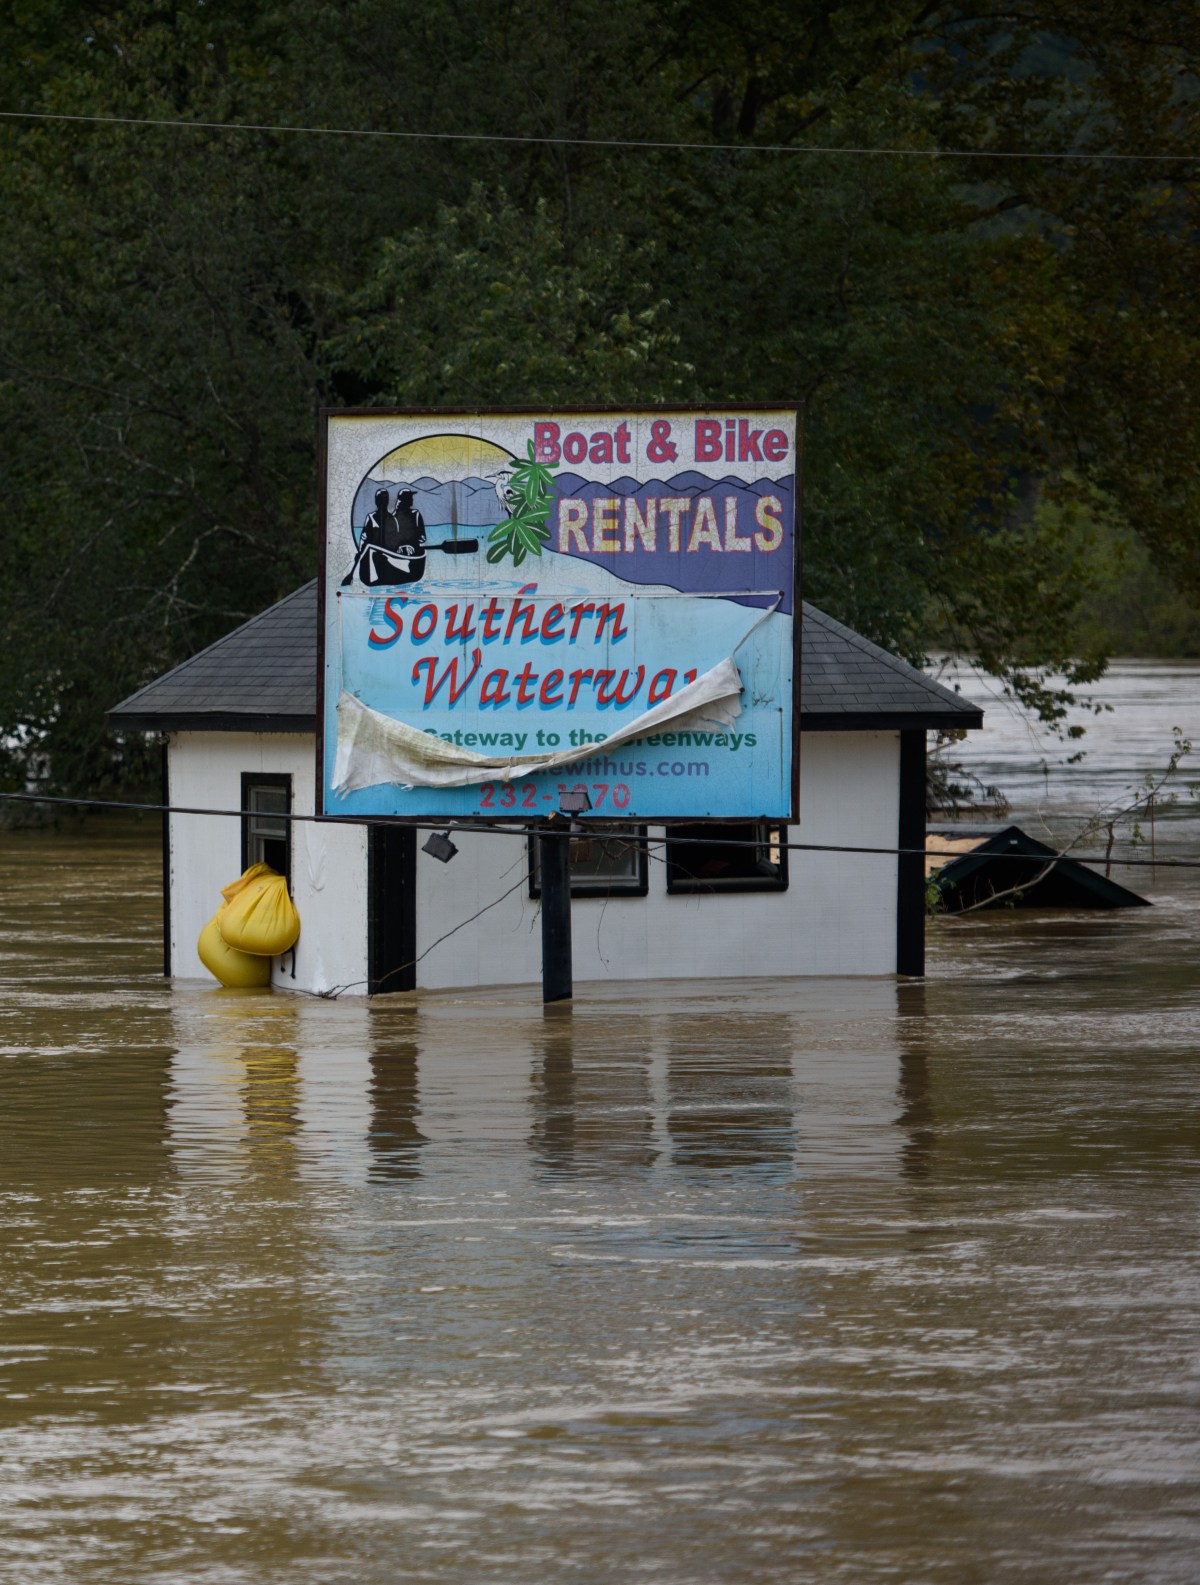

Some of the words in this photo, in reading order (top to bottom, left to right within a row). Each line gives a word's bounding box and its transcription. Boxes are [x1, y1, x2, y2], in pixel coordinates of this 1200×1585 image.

[533, 421, 631, 464] Boat
[646, 420, 679, 464] &
[694, 419, 789, 463] Bike
[557, 496, 784, 553] RENTALS
[367, 583, 628, 645] Southern
[411, 649, 700, 711] Waterwa
[536, 729, 561, 747] to
[568, 729, 609, 747] the
